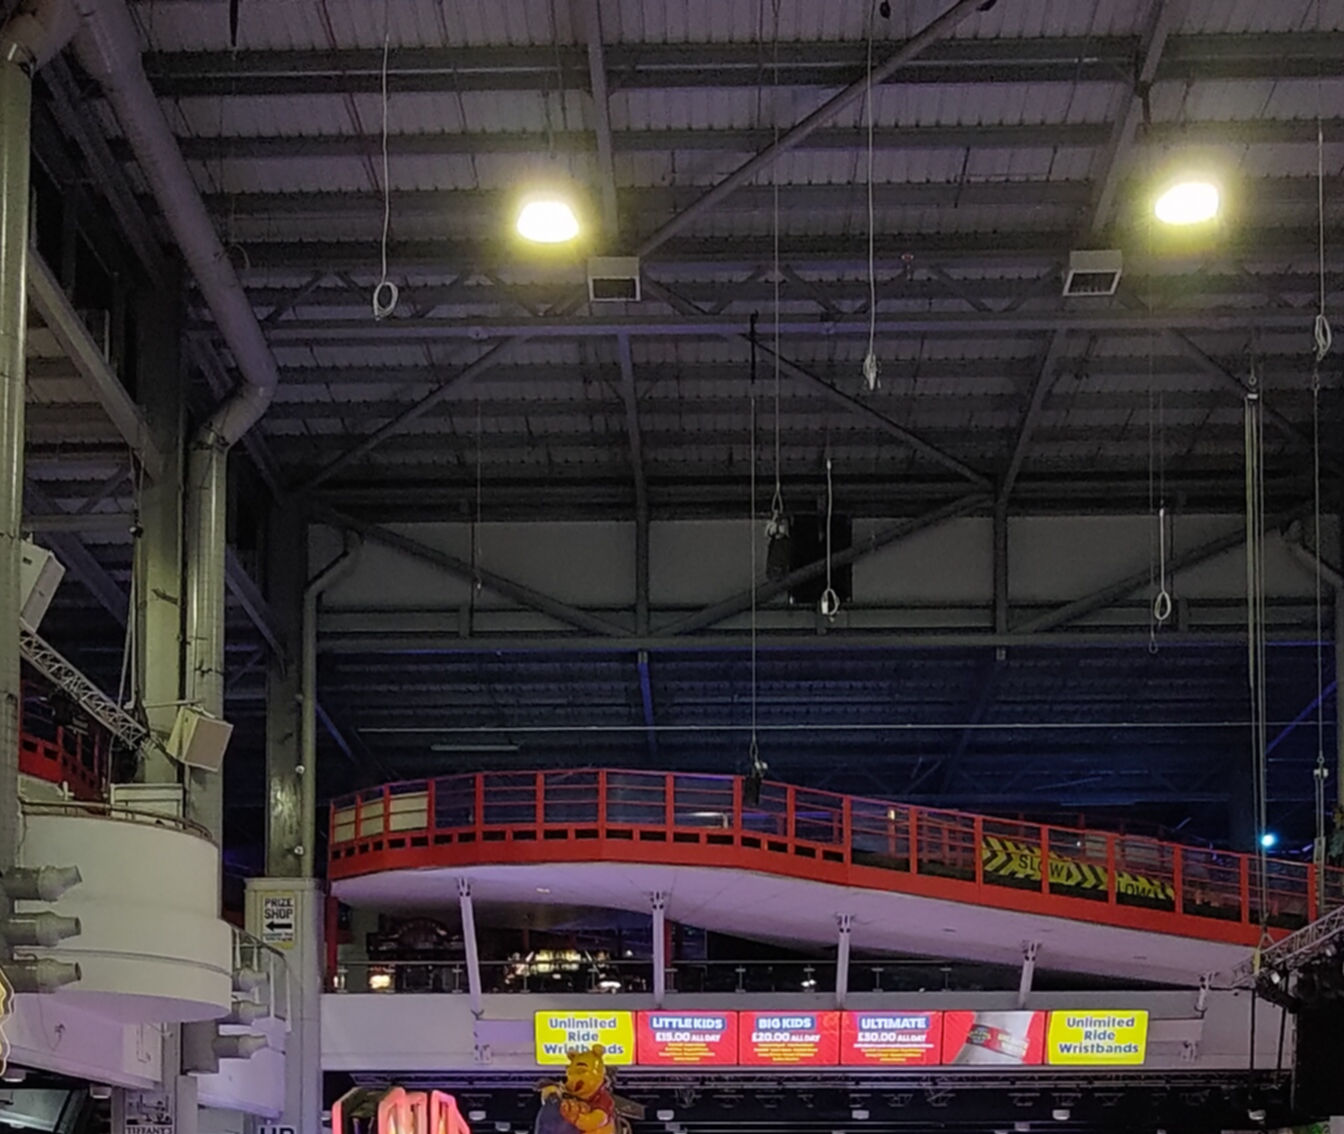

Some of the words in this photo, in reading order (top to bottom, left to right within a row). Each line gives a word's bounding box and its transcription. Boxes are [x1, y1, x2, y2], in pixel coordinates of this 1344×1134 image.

[549, 1017, 617, 1029] Unlimited
[653, 1018, 692, 1029] LITTLE
[694, 1018, 724, 1029] KIDS
[758, 1017, 780, 1028] BIG
[783, 1017, 812, 1028] KIDS
[862, 1017, 926, 1029] ULTIMATE
[1067, 1016, 1135, 1027] Unlimited
[568, 1031, 599, 1042] Ride
[1084, 1030, 1116, 1041] Ride
[1059, 1043, 1138, 1053] Wristbands
[127, 1126, 172, 1134] TIFFANY'S
